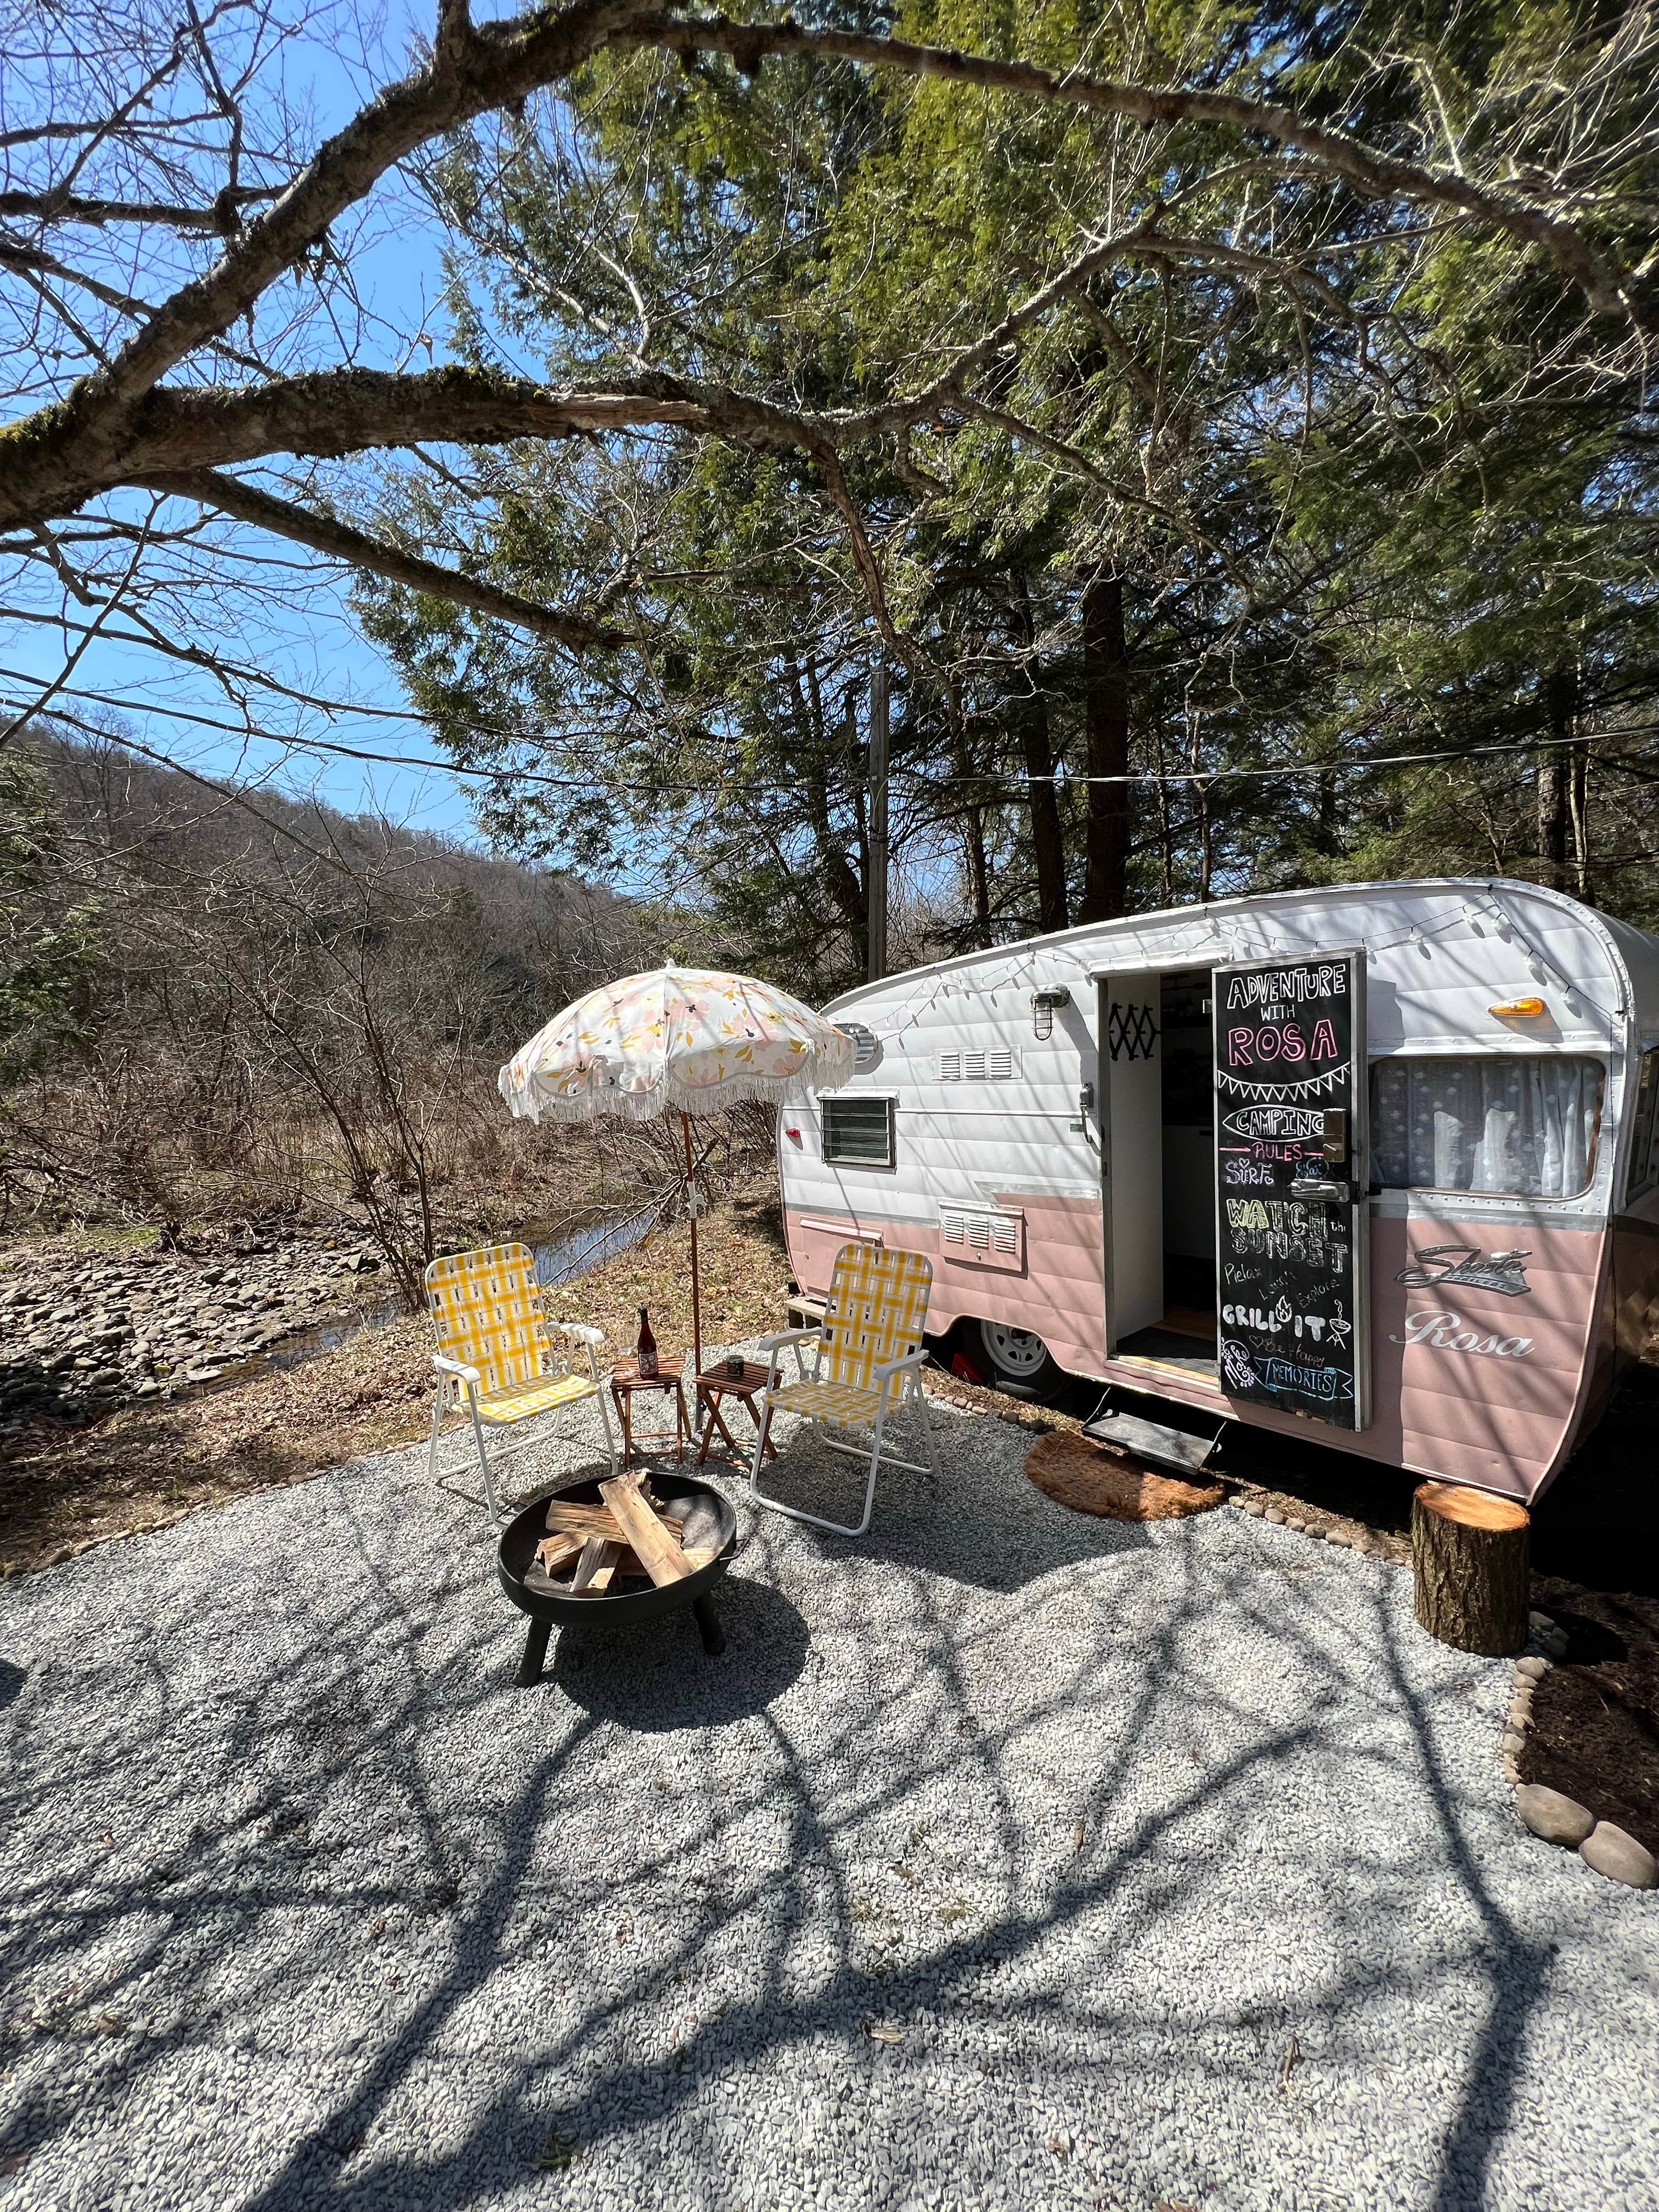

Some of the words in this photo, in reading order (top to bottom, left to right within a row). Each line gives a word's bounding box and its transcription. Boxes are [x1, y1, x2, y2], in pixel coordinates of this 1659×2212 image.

[1227, 964, 1346, 1009] ADVENTURE
[1261, 1005, 1295, 1022] WITH
[1228, 1019, 1339, 1066] ROSA
[1236, 1109, 1324, 1136] CAMPING
[1252, 1142, 1302, 1161] RULES
[1227, 1198, 1328, 1241] WATCH
[1231, 1227, 1348, 1273] SUNSET
[1224, 1262, 1263, 1285] Relax
[1296, 1279, 1341, 1308] Explore
[1222, 1304, 1283, 1333] GRILL
[1295, 1314, 1326, 1341] IT
[1389, 1310, 1536, 1357] Rosa
[1265, 1338, 1286, 1353] Be
[1222, 1339, 1253, 1390] Make
[1272, 1363, 1332, 1392] MEMORIES
